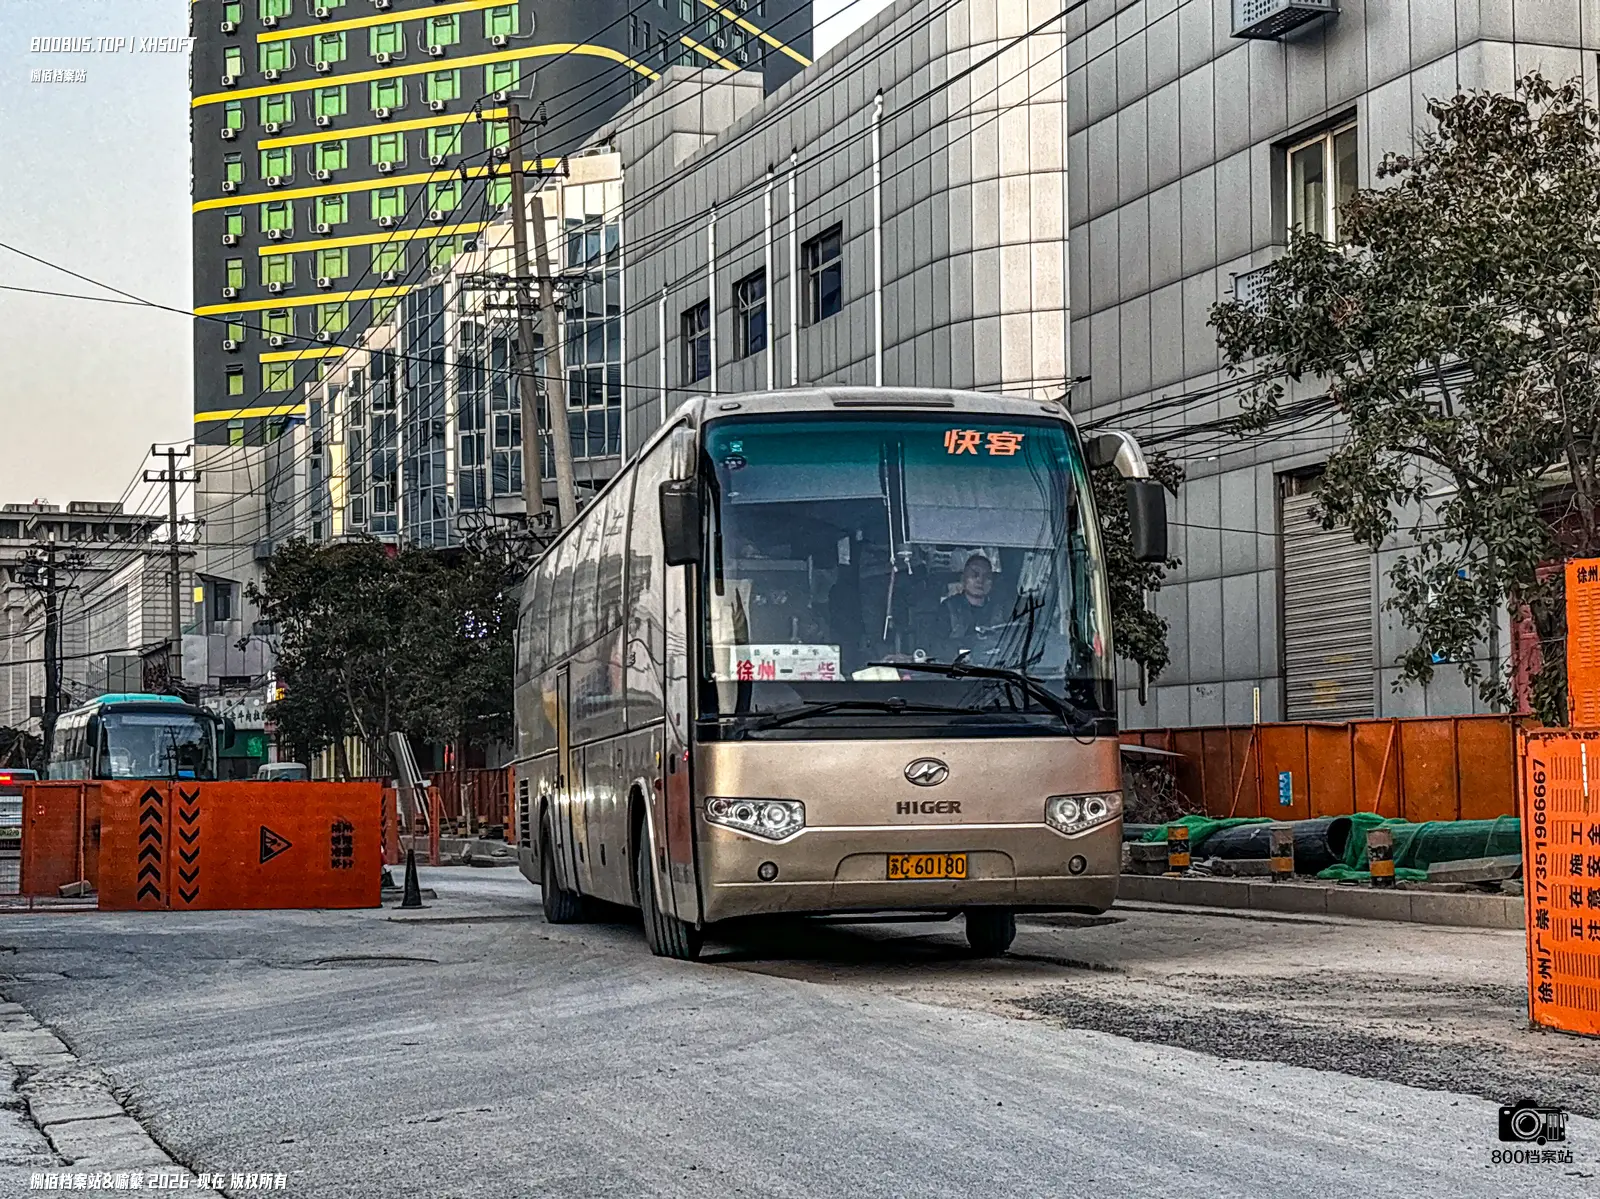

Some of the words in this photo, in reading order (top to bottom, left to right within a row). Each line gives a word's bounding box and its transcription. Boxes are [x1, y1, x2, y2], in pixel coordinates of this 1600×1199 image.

[944, 429, 1025, 456] 快客
[1576, 564, 1600, 584] 徐州
[896, 800, 962, 815] HIGER
[1569, 822, 1583, 941] 正在施工
[1586, 822, 1600, 942] 注意安全
